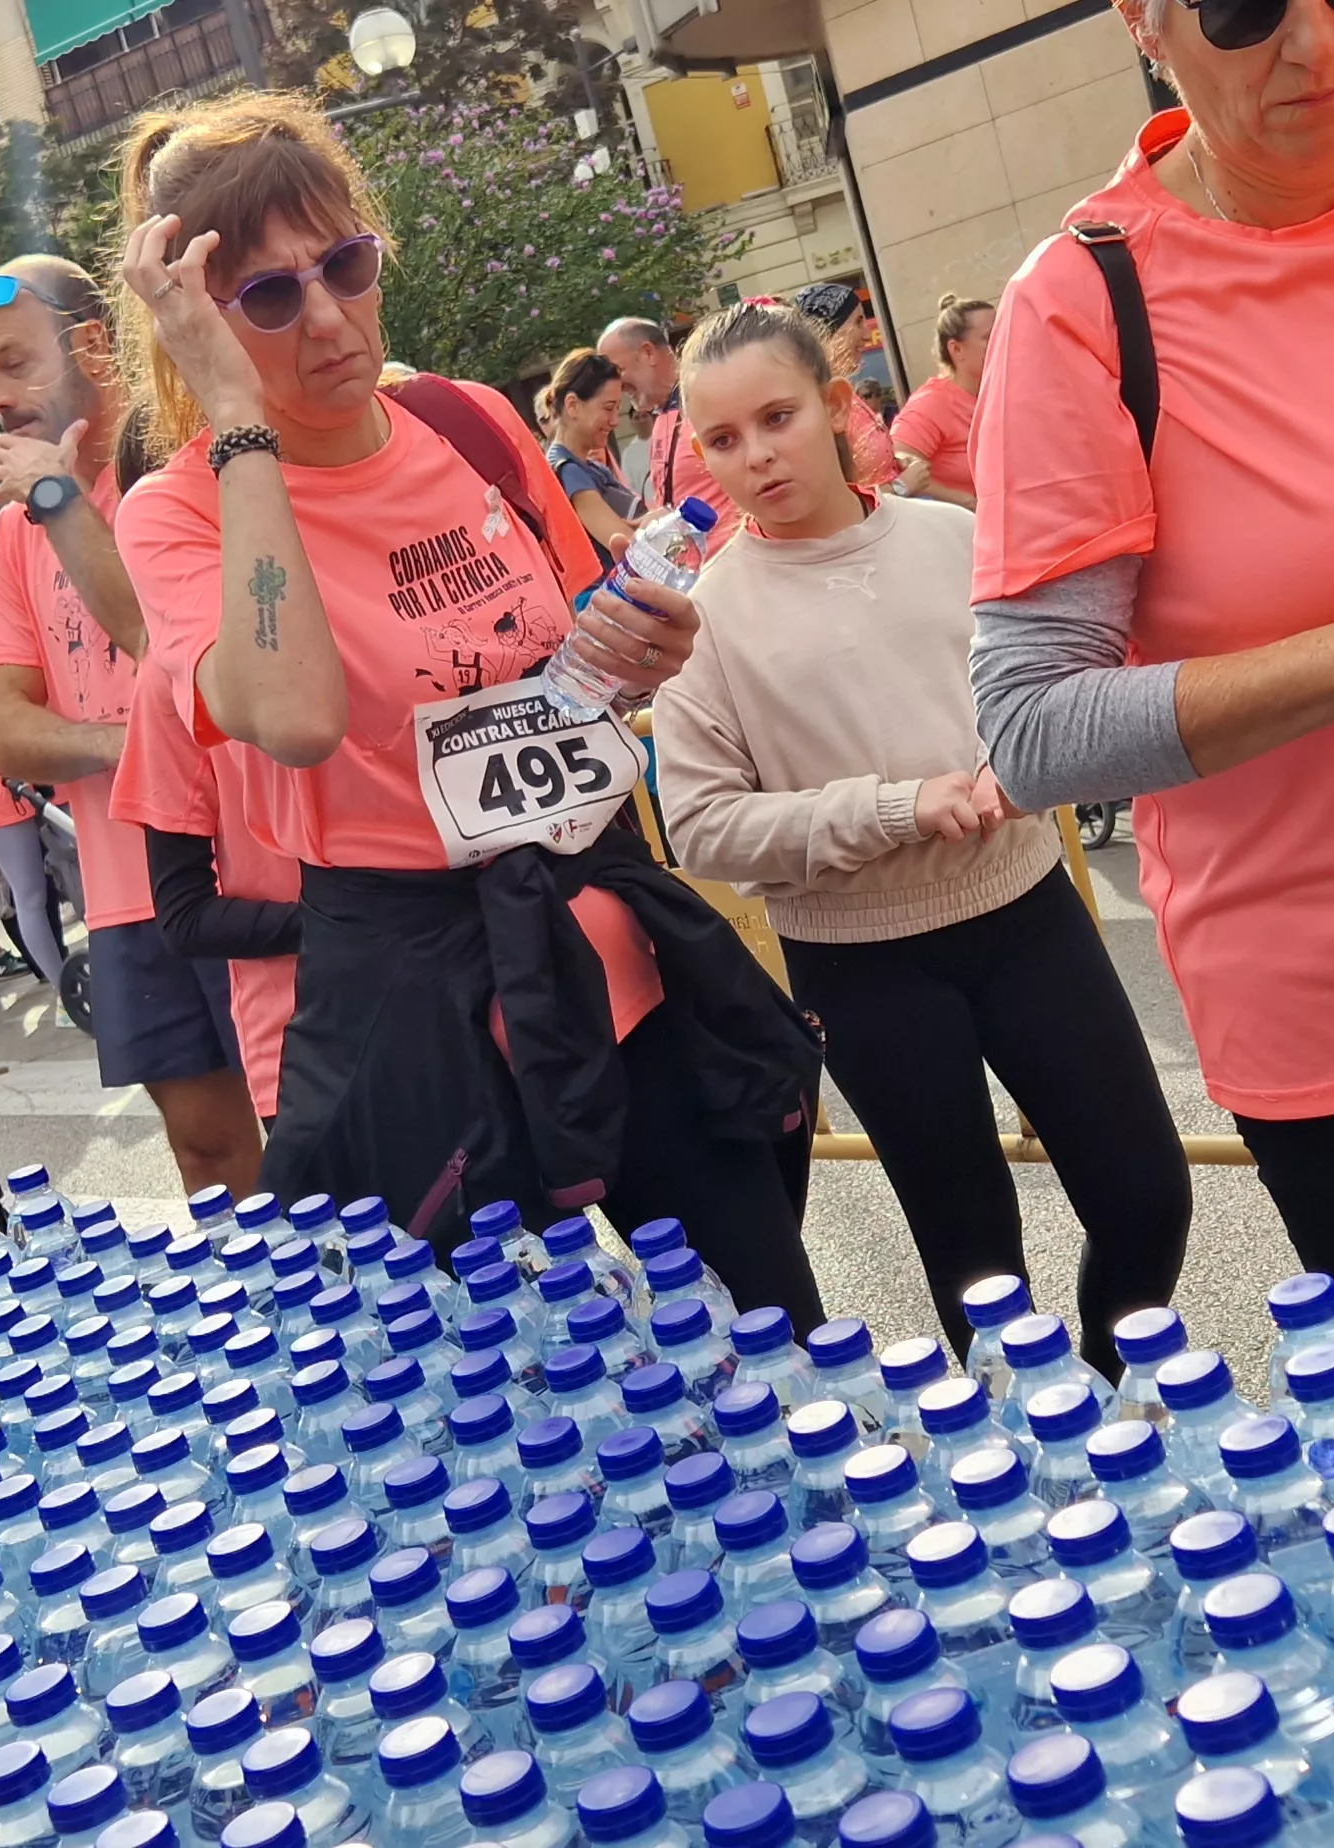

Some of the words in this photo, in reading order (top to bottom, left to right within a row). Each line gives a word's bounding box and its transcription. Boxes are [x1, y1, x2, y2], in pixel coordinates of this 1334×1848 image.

[388, 525, 477, 588] CORRAMOS
[387, 586, 428, 622] POR
[419, 578, 447, 613] LA
[440, 551, 511, 606] CIENCIA
[458, 669, 471, 685] 19
[492, 699, 545, 721] HUESCA
[441, 723, 515, 755] CONTRA
[514, 720, 535, 737] EL
[478, 736, 613, 818] 495
